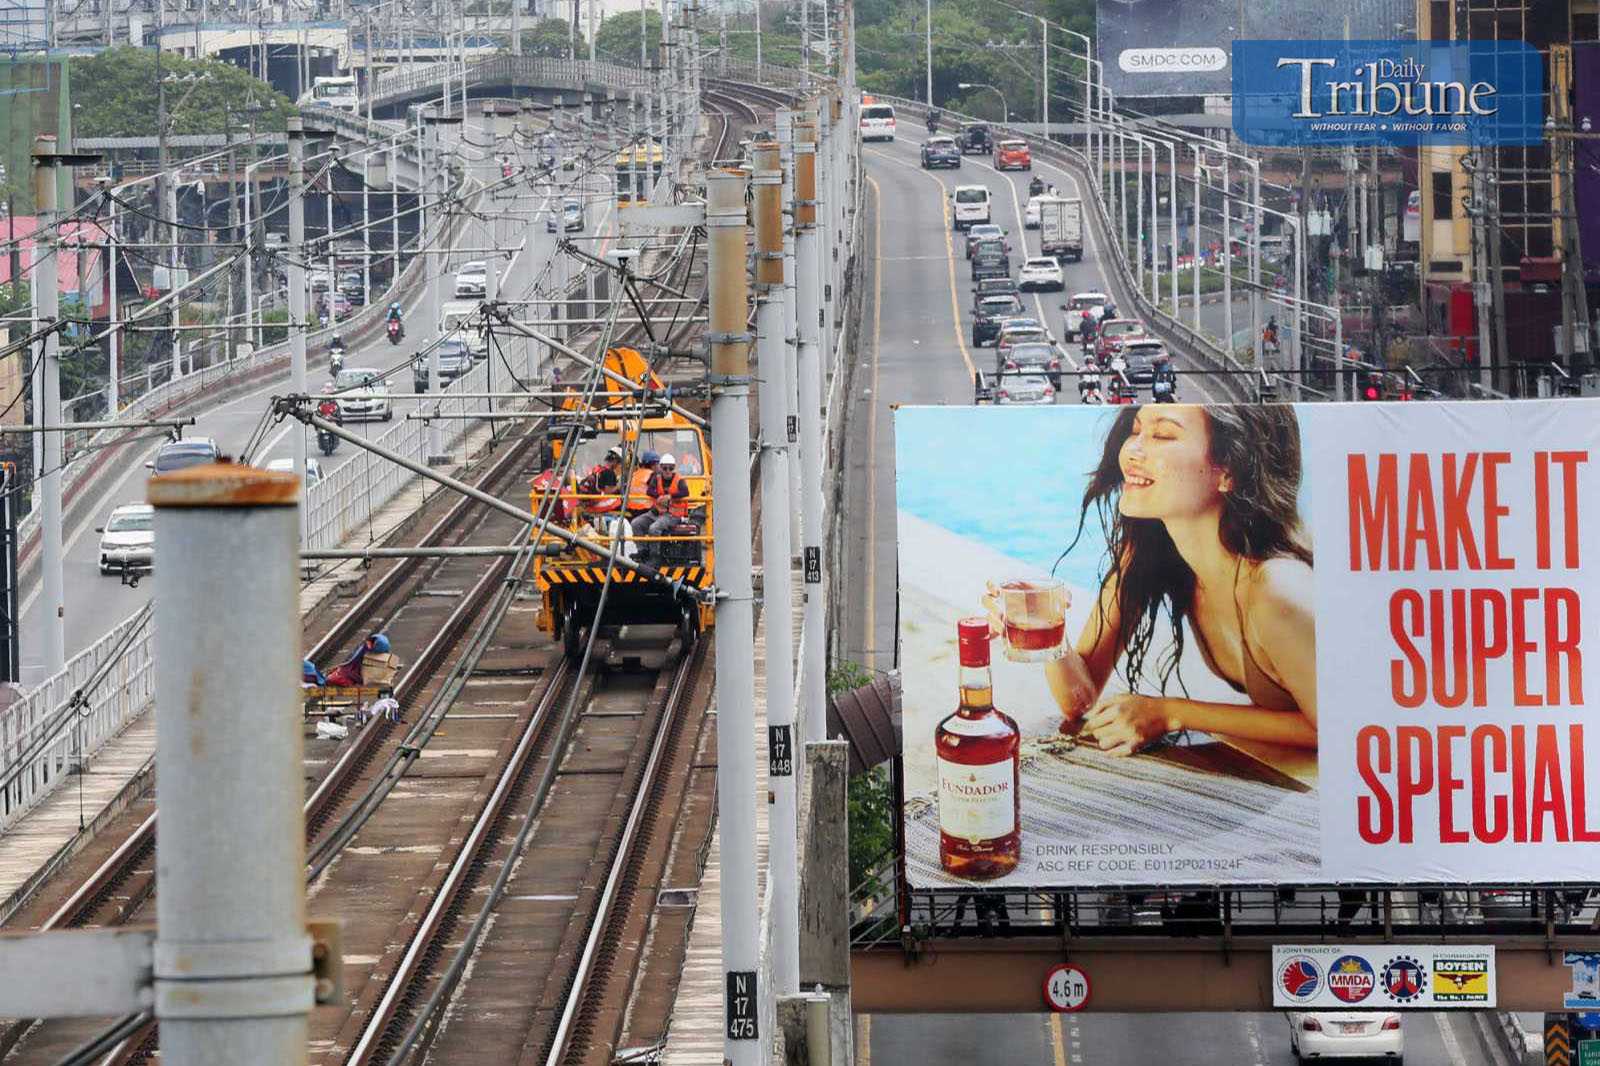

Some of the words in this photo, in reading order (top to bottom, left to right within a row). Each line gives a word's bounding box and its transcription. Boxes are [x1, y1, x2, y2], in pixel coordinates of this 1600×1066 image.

[1130, 54, 1216, 66] SMDC.COM
[1347, 452, 1515, 572] MAKE
[1534, 450, 1588, 570] IT
[809, 548, 816, 559] N
[809, 559, 817, 570] 17
[807, 570, 819, 582] 413
[1389, 587, 1585, 708] SUPER
[775, 728, 784, 742] N
[774, 743, 786, 758] 17
[771, 759, 791, 774] 448
[942, 777, 1008, 796] FUNDADOR
[1356, 724, 1600, 845] SPECIAL
[1036, 844, 1078, 856] DRINK
[1082, 844, 1175, 855] RESPONSIBLY
[1036, 860, 1064, 872] ASC
[1068, 860, 1094, 872] REF
[1436, 962, 1484, 971] BOYSEN
[736, 975, 747, 994] N
[1331, 975, 1371, 986] MMDA
[1053, 980, 1071, 997] 4.6
[1074, 983, 1084, 997] m
[734, 997, 749, 1016] 17
[730, 1018, 754, 1037] 475
